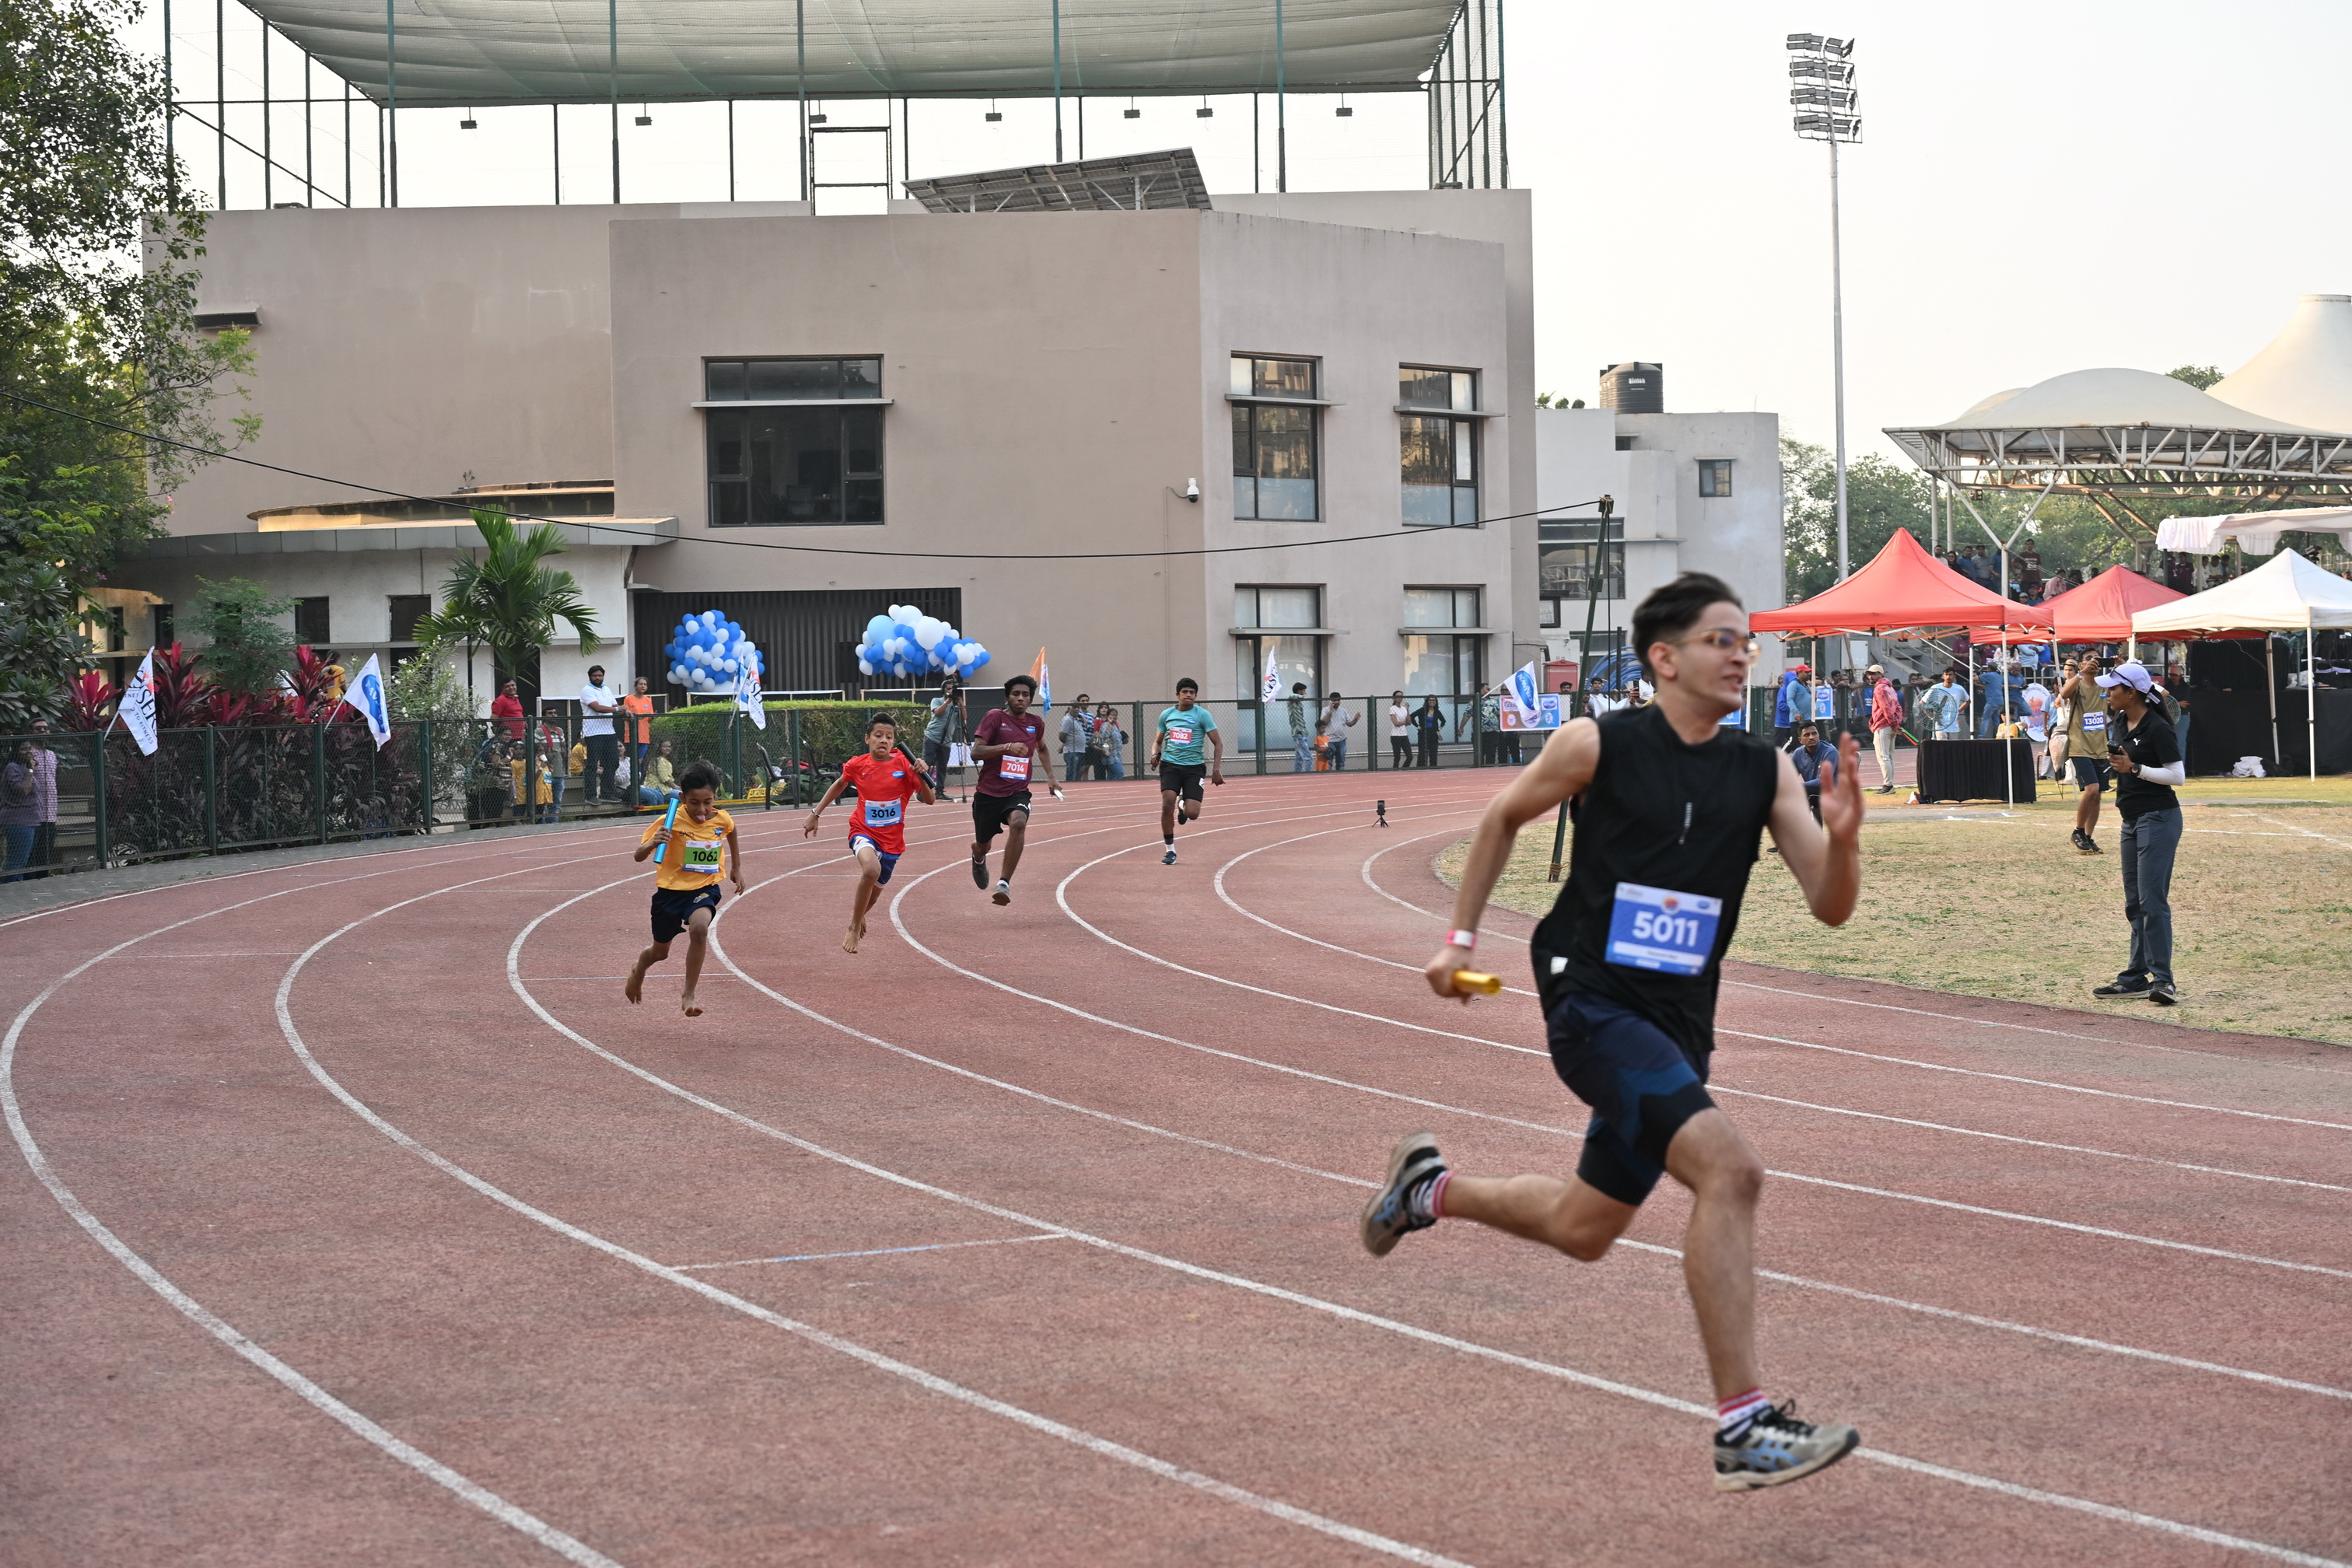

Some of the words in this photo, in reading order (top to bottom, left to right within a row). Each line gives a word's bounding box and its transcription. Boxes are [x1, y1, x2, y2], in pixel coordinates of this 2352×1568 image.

[1006, 762, 1024, 772] 7014
[870, 808, 896, 818] 3016
[692, 850, 718, 863] 1062
[1632, 910, 1699, 947] 5011
